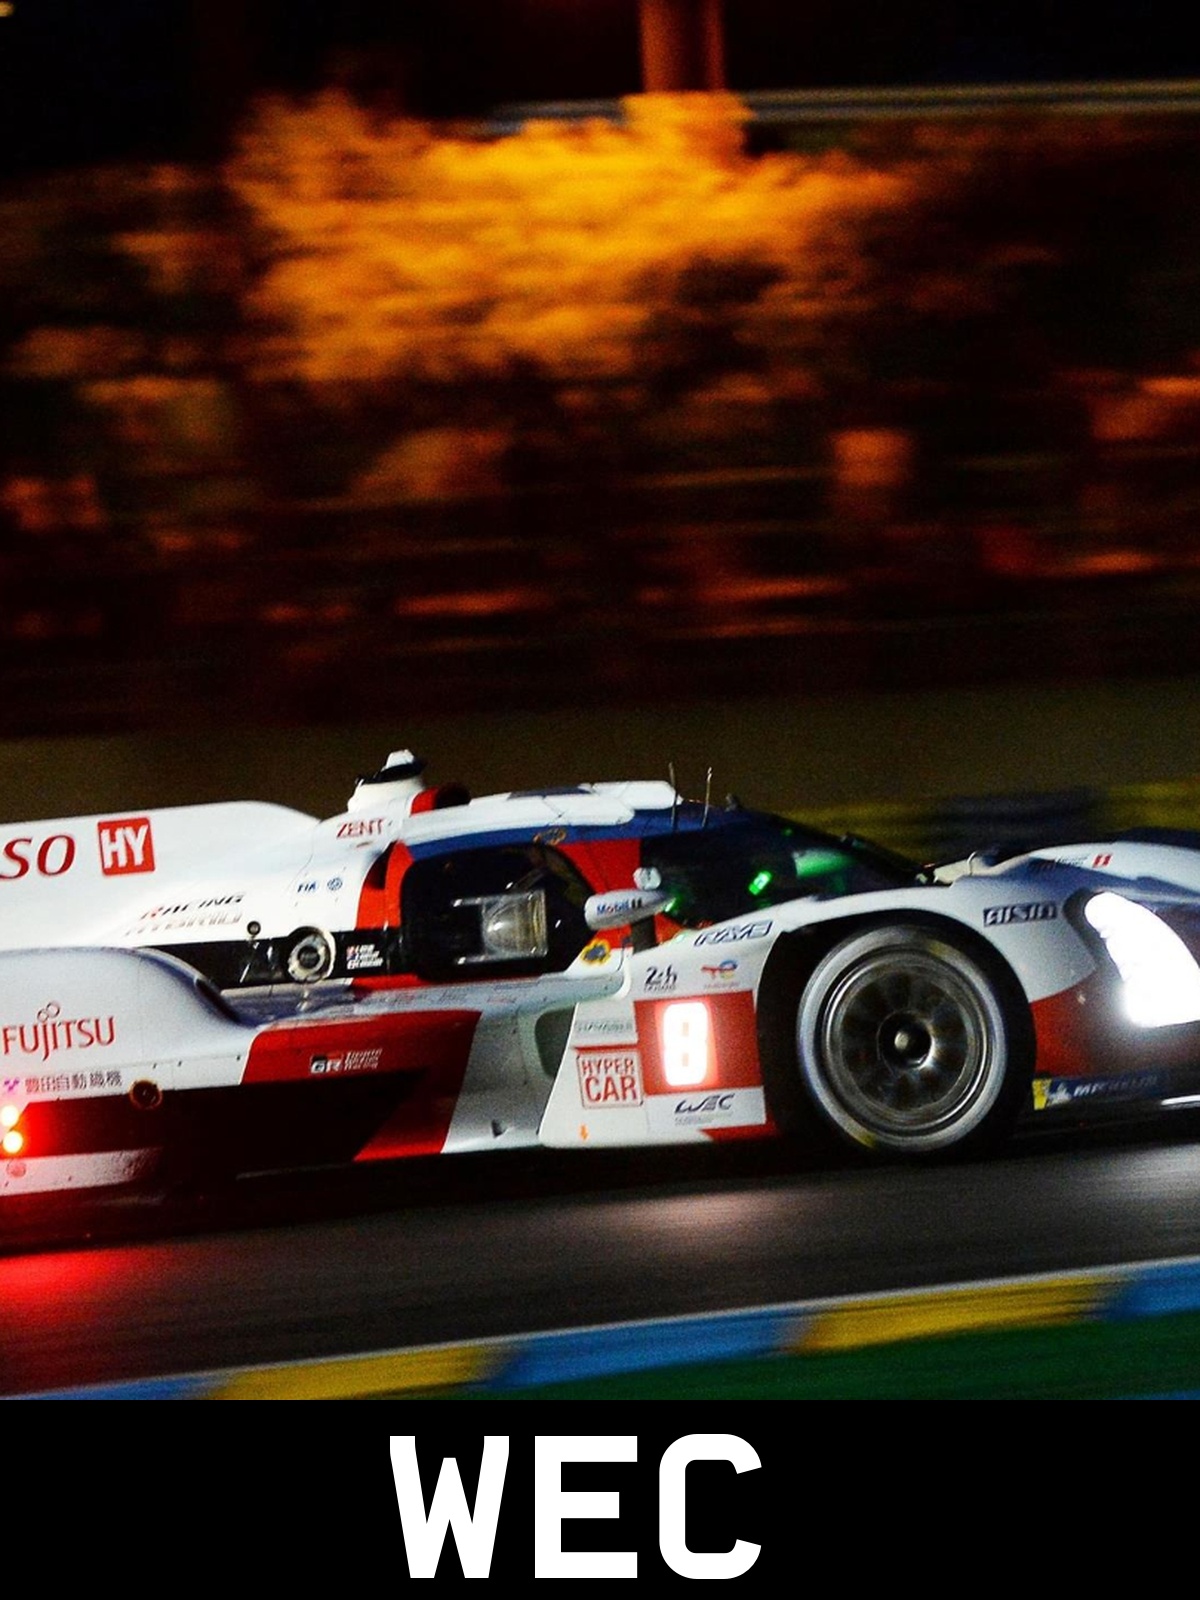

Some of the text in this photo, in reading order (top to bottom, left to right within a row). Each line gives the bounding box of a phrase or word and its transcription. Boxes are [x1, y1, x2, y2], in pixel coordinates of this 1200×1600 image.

[336, 818, 385, 838] ZENT
[100, 825, 148, 869] HY
[297, 881, 316, 892] FIA
[2, 1014, 115, 1061] FUJITSU
[664, 1003, 708, 1086] 8
[311, 1059, 341, 1074] GR
[582, 1057, 634, 1075] HYPER
[585, 1077, 637, 1102] CAR
[675, 1093, 735, 1114] WEC
